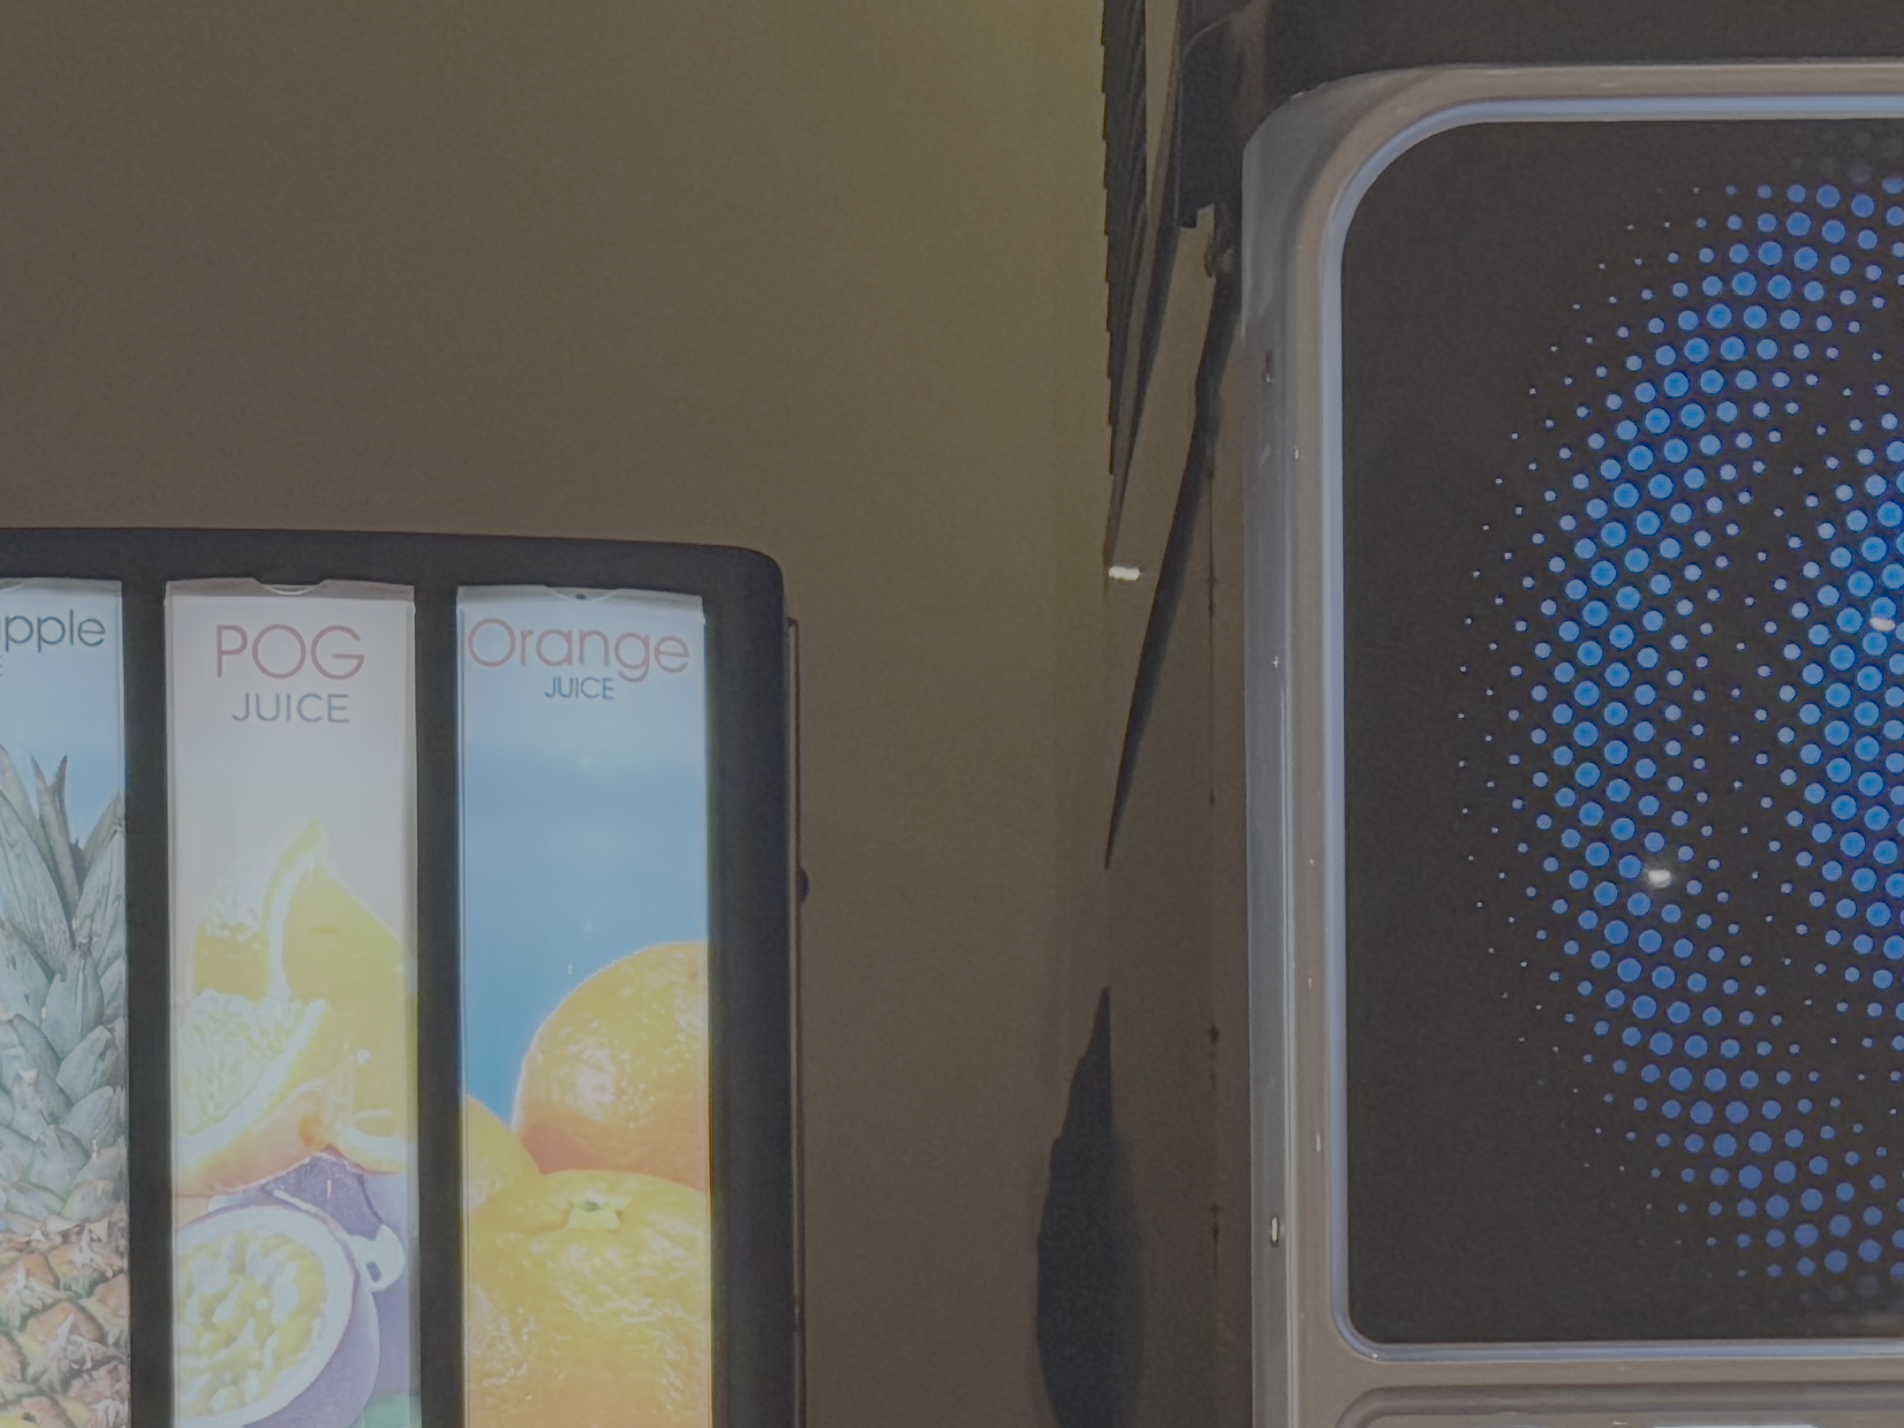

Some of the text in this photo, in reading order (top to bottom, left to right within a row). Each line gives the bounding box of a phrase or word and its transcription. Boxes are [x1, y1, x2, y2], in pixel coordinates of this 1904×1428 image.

[215, 623, 366, 681] POG
[468, 617, 691, 683] Orange
[230, 691, 352, 724] JUICE
[543, 675, 616, 701] JUICE
